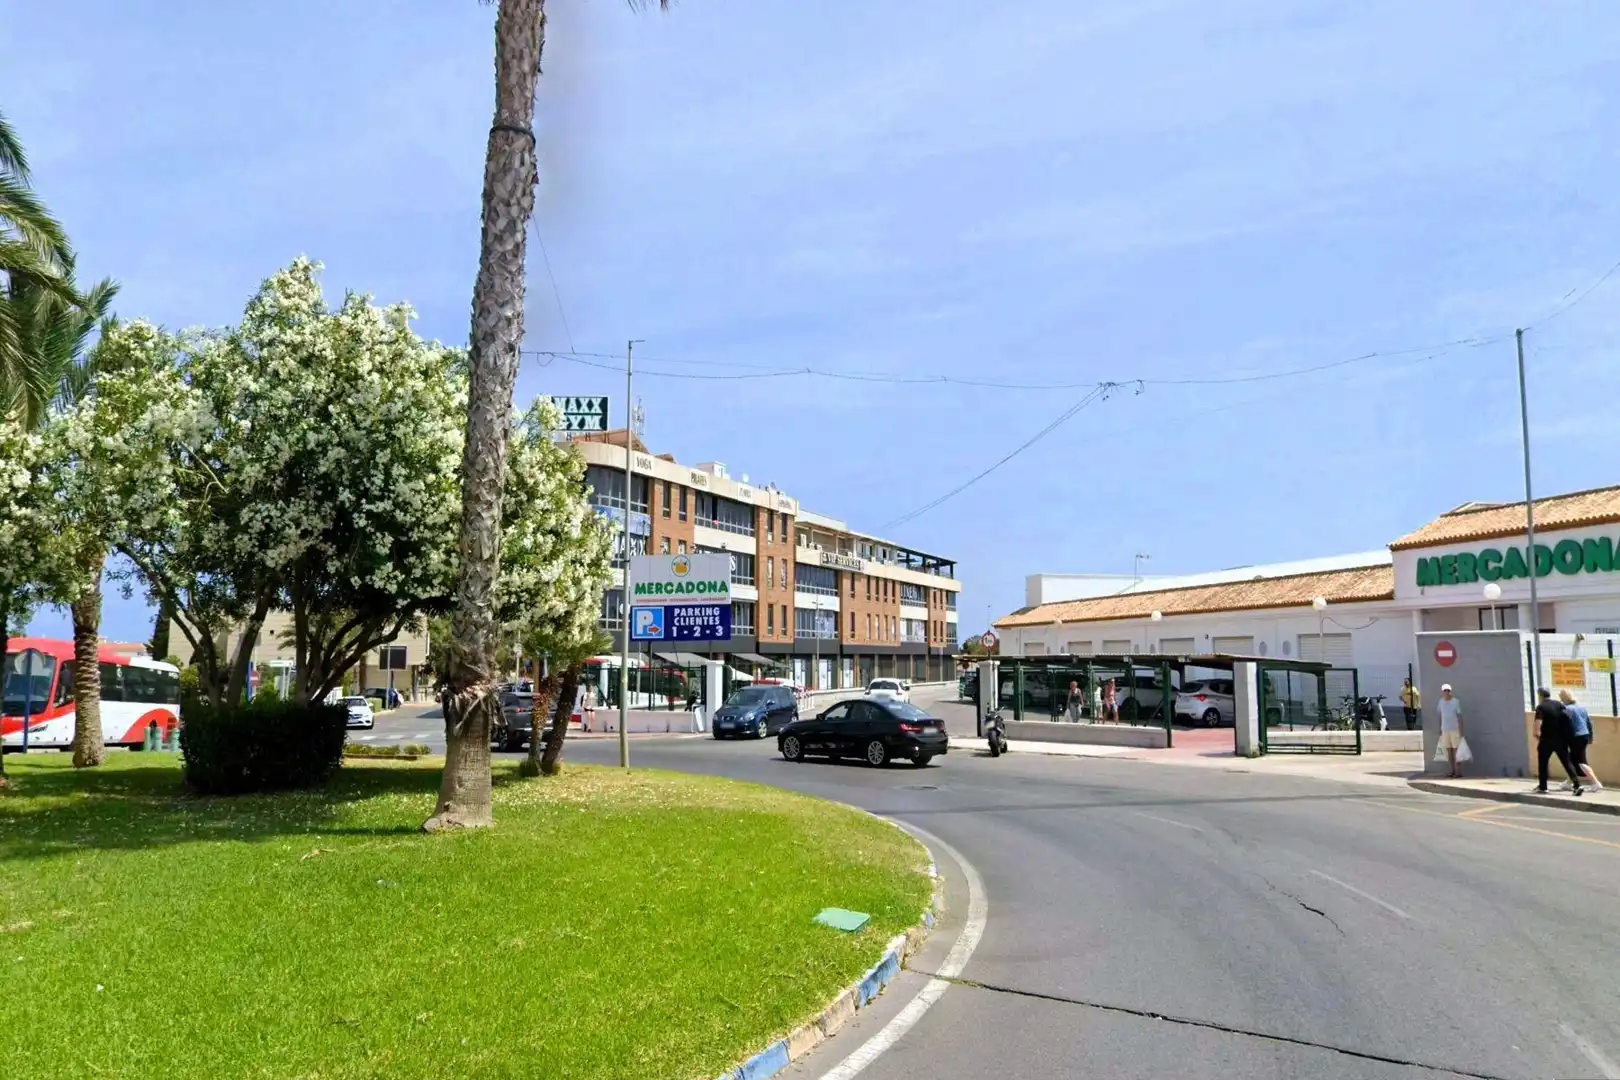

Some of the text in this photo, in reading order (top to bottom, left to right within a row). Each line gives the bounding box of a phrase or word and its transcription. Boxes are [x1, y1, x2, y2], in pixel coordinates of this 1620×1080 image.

[554, 397, 602, 413] MAXX
[636, 456, 652, 471] YOGA
[635, 581, 729, 594] MERCADONA
[674, 608, 720, 616] PARKING
[637, 610, 654, 635] P
[674, 617, 720, 625] CLIENTES
[693, 626, 701, 637] 2
[715, 626, 724, 637] 3
